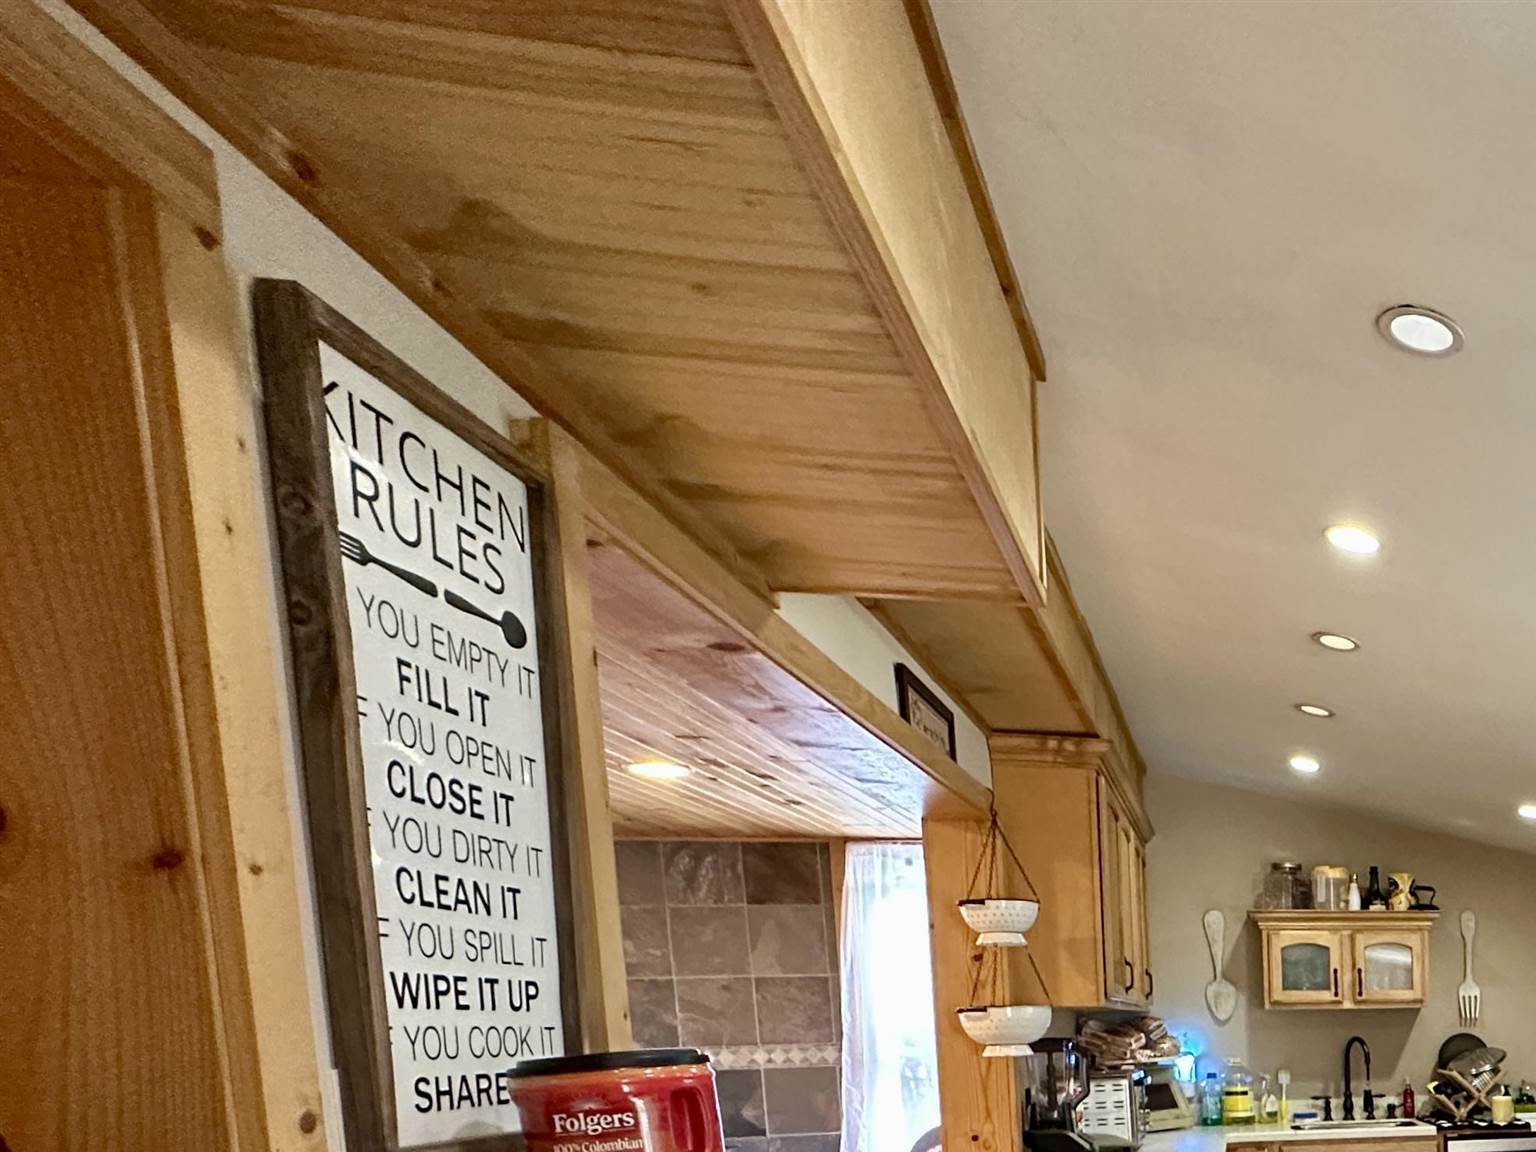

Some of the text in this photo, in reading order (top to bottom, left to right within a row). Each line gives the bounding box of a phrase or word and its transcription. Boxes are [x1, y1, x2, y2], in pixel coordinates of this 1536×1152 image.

[350, 460, 505, 595] RULES
[357, 586, 536, 699] YOU EMPTY IT
[396, 657, 459, 716] FILL
[468, 687, 490, 727] IT
[378, 702, 435, 755] YOU
[446, 730, 512, 781] OPEN
[520, 755, 536, 788] IT
[387, 760, 485, 820] CLOSE
[494, 791, 514, 826] IT
[383, 810, 442, 858] YOU
[453, 829, 518, 873] DIRTY
[526, 845, 543, 878] IT
[396, 866, 521, 920] CLEAN IT
[399, 919, 454, 960] YOU
[464, 929, 524, 967] SPILL
[531, 937, 547, 968] IT
[390, 971, 539, 1012] WIPE IT UP
[404, 1026, 459, 1061] YOU
[469, 1026, 534, 1058] COOK
[540, 1027, 555, 1056] IT
[414, 1072, 510, 1113] SHARE
[552, 1112, 635, 1135] Folgers
